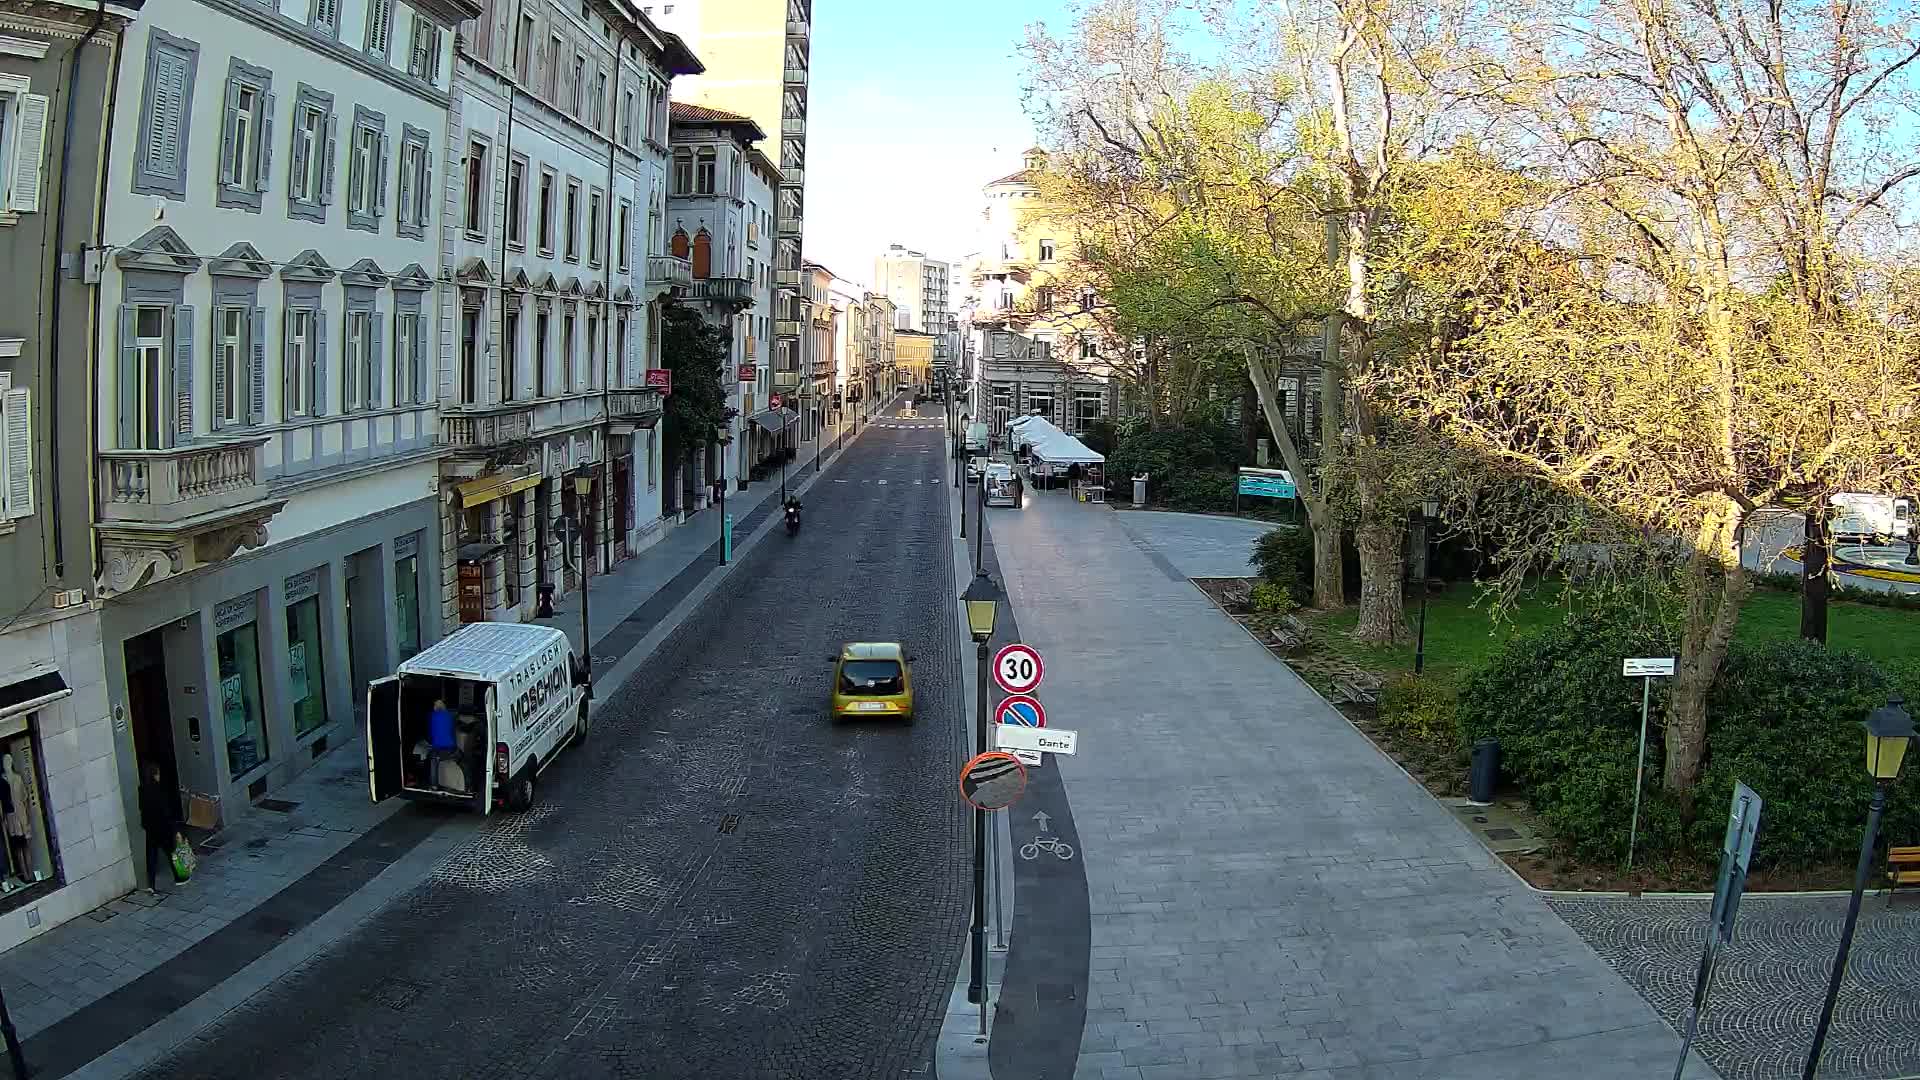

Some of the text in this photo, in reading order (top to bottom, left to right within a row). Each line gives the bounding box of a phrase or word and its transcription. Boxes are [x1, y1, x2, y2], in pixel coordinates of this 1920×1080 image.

[510, 643, 563, 690] TRASLOCHI
[1006, 658, 1032, 680] 30
[510, 660, 567, 732] MOSCHION
[1038, 738, 1070, 749] Dante
